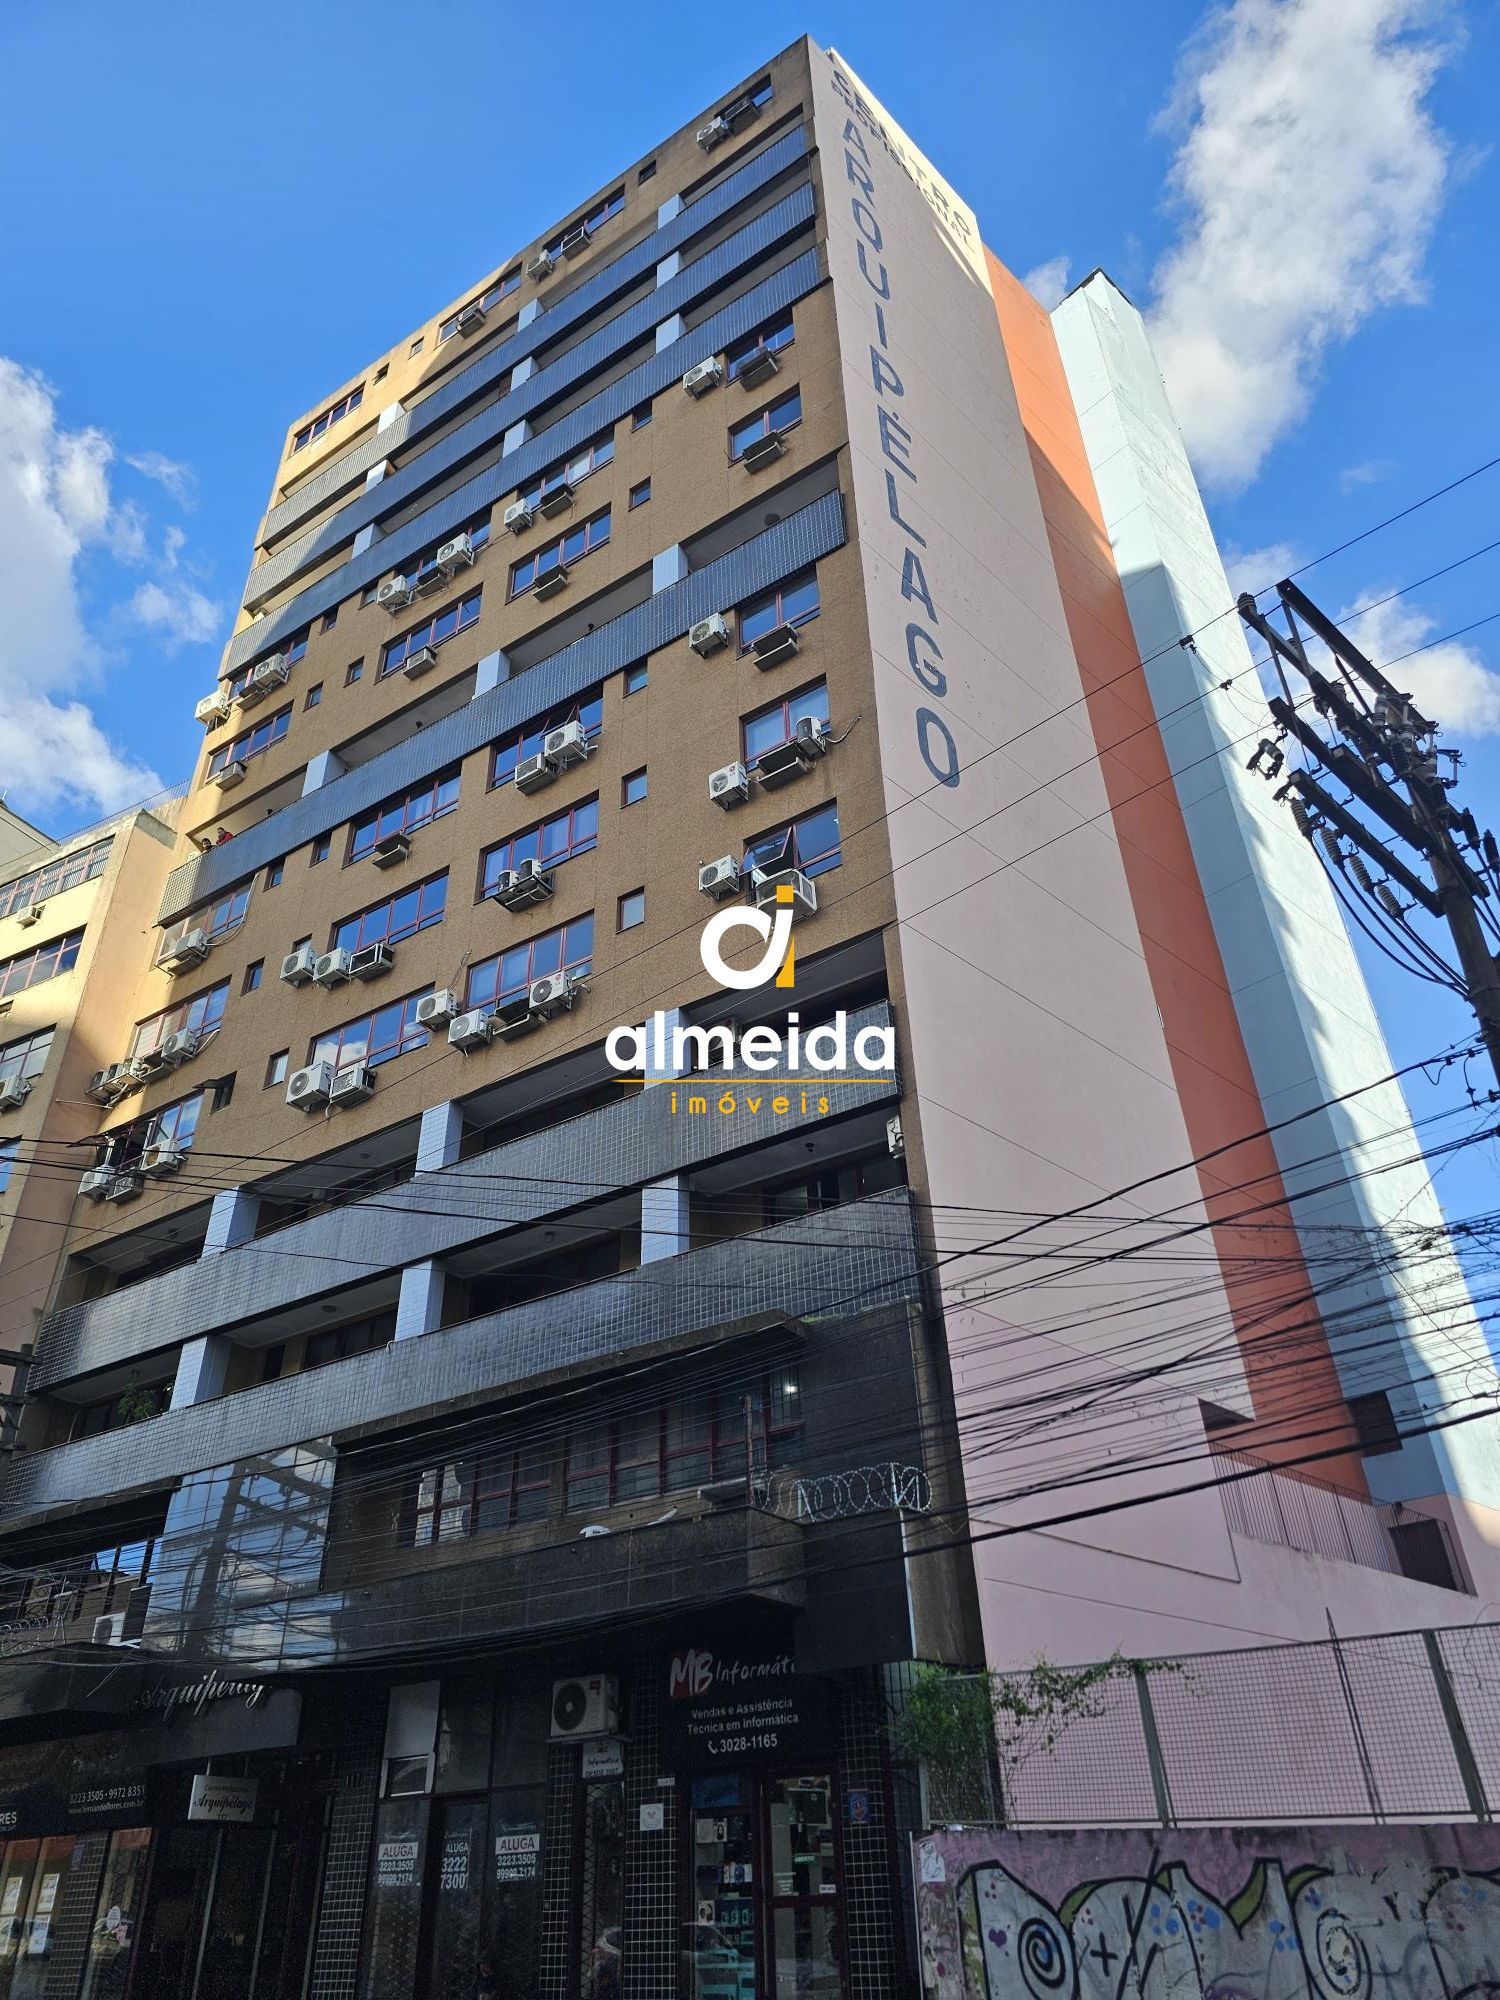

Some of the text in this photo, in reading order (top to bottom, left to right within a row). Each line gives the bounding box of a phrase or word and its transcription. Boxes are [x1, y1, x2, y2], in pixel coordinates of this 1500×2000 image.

[669, 1647, 796, 1697] MB Informáti
[691, 1698, 793, 1720] Vendas e Assistência
[726, 1720, 741, 1731] em
[719, 1733, 778, 1753] 3028-1165
[86, 1790, 104, 1802] 3505
[108, 1787, 126, 1800] 9972
[446, 1842, 469, 1854] ALUGA
[500, 1837, 535, 1851] ALUGA
[382, 1845, 414, 1858] ALUGA
[440, 1856, 467, 1873] 3222
[497, 1853, 537, 1867] 3223.3505
